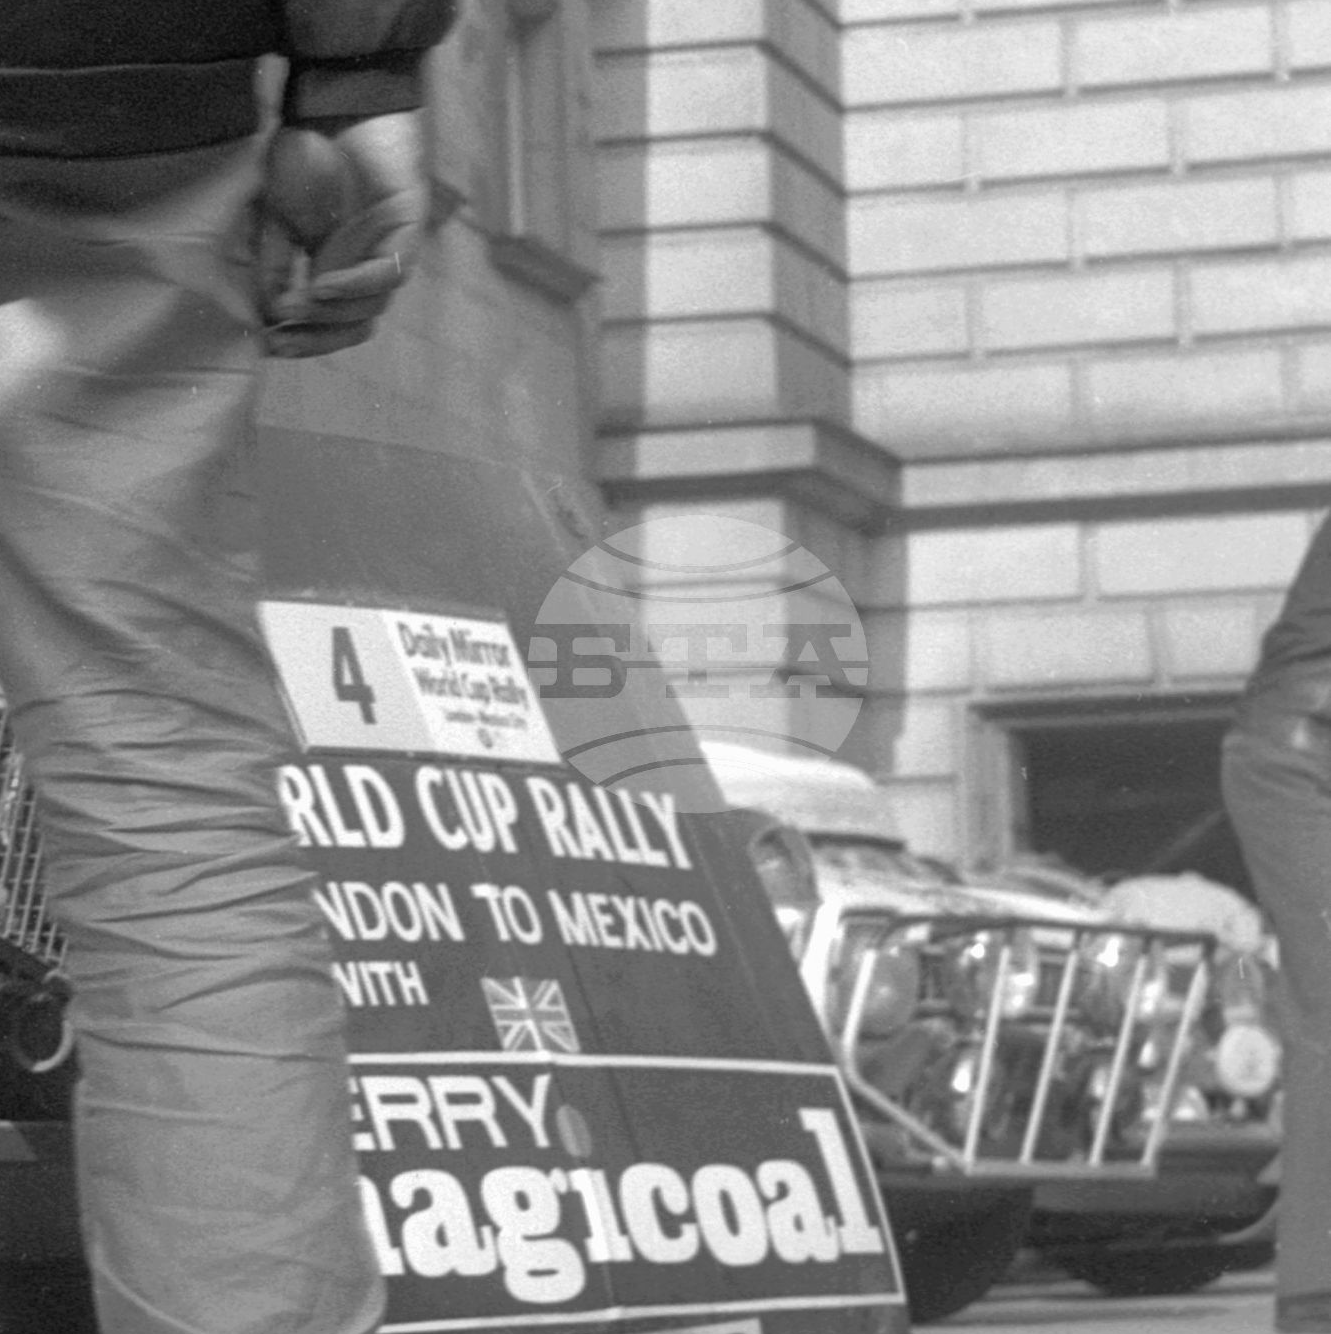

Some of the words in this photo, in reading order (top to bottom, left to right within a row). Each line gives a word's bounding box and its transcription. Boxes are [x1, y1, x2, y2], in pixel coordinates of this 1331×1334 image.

[331, 626, 377, 725] 4
[415, 765, 518, 854] CUP
[526, 776, 693, 870] RALLY
[470, 883, 543, 945] TO
[547, 889, 717, 957] MEXICO
